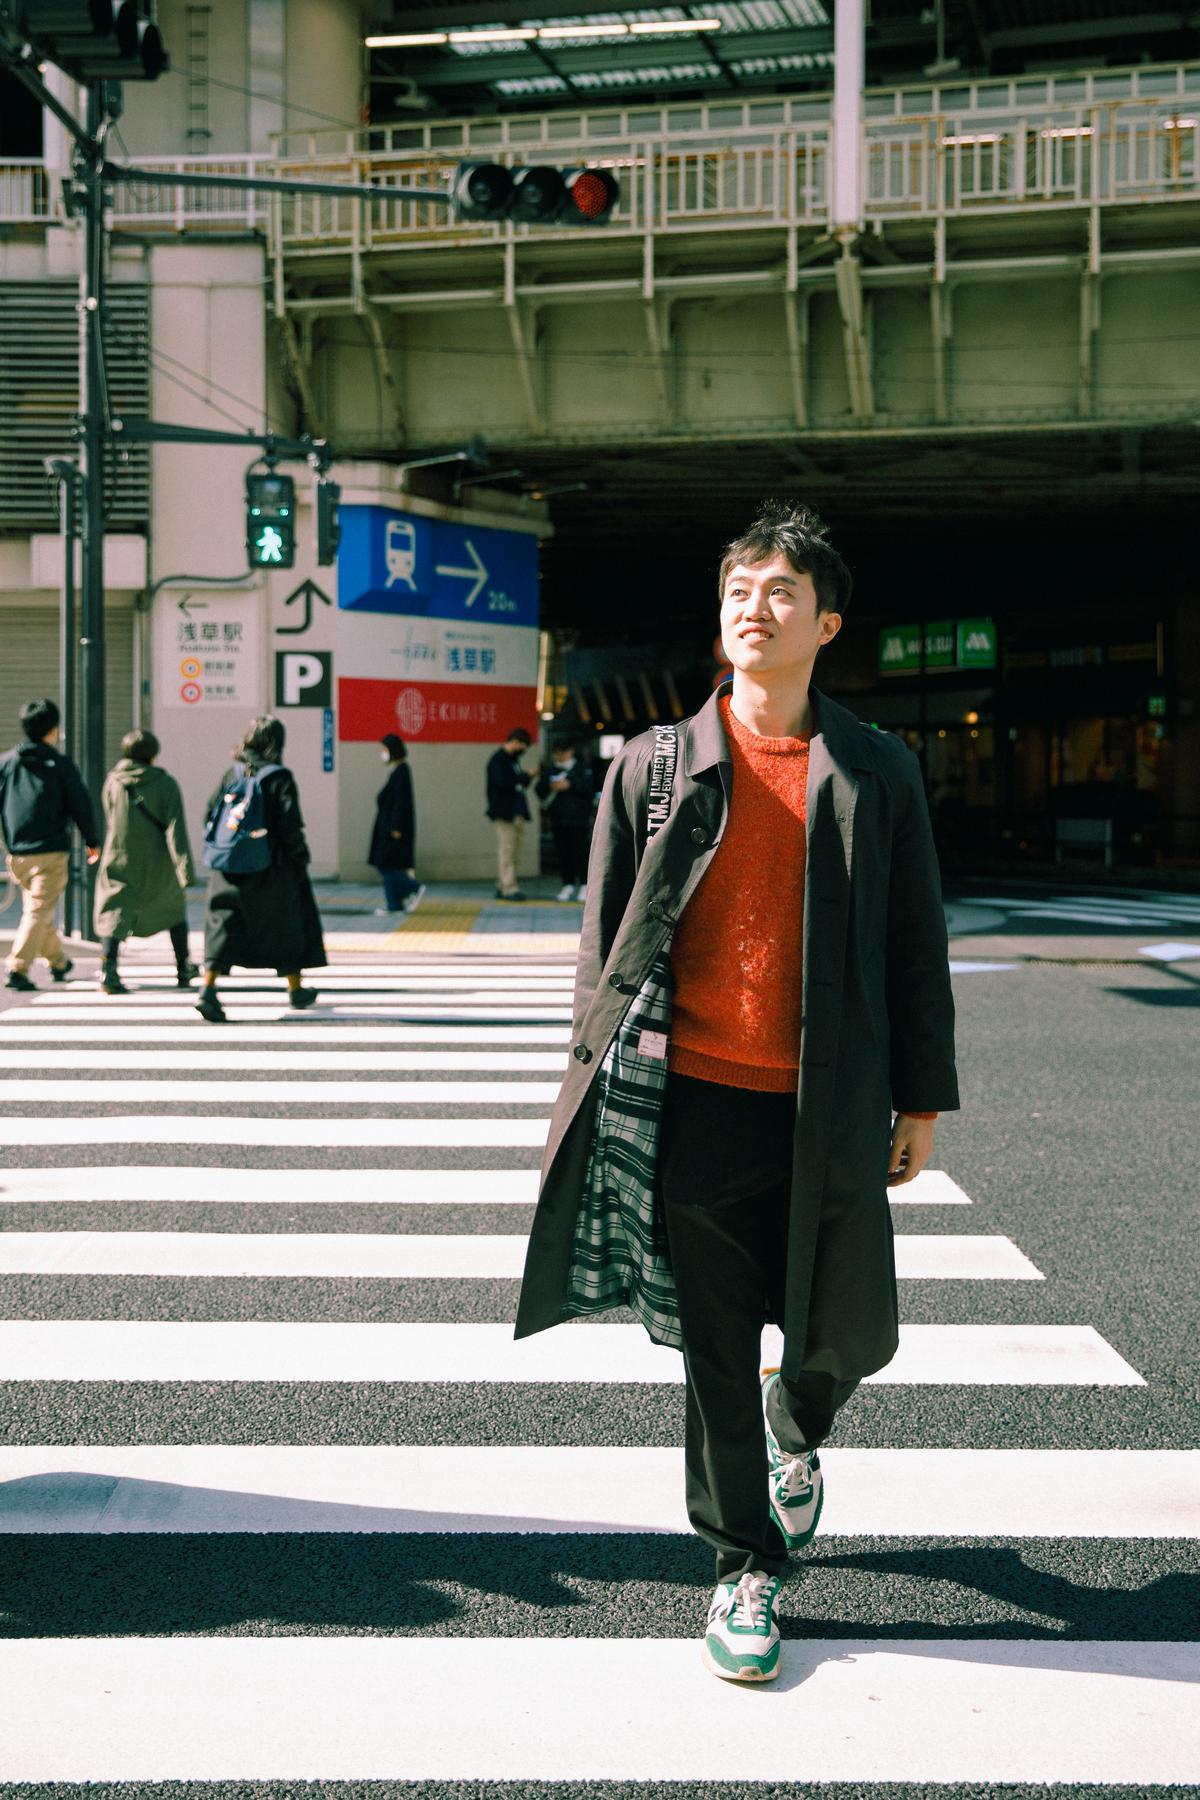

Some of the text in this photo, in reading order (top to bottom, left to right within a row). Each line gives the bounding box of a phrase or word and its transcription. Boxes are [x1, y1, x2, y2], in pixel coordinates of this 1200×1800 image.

[177, 622, 243, 642] 浅草駅
[446, 647, 496, 674] 浅草駅
[283, 654, 324, 705] P
[428, 703, 497, 723] EKIMISE
[650, 757, 664, 792] LIMITED
[662, 758, 675, 792] EDITION
